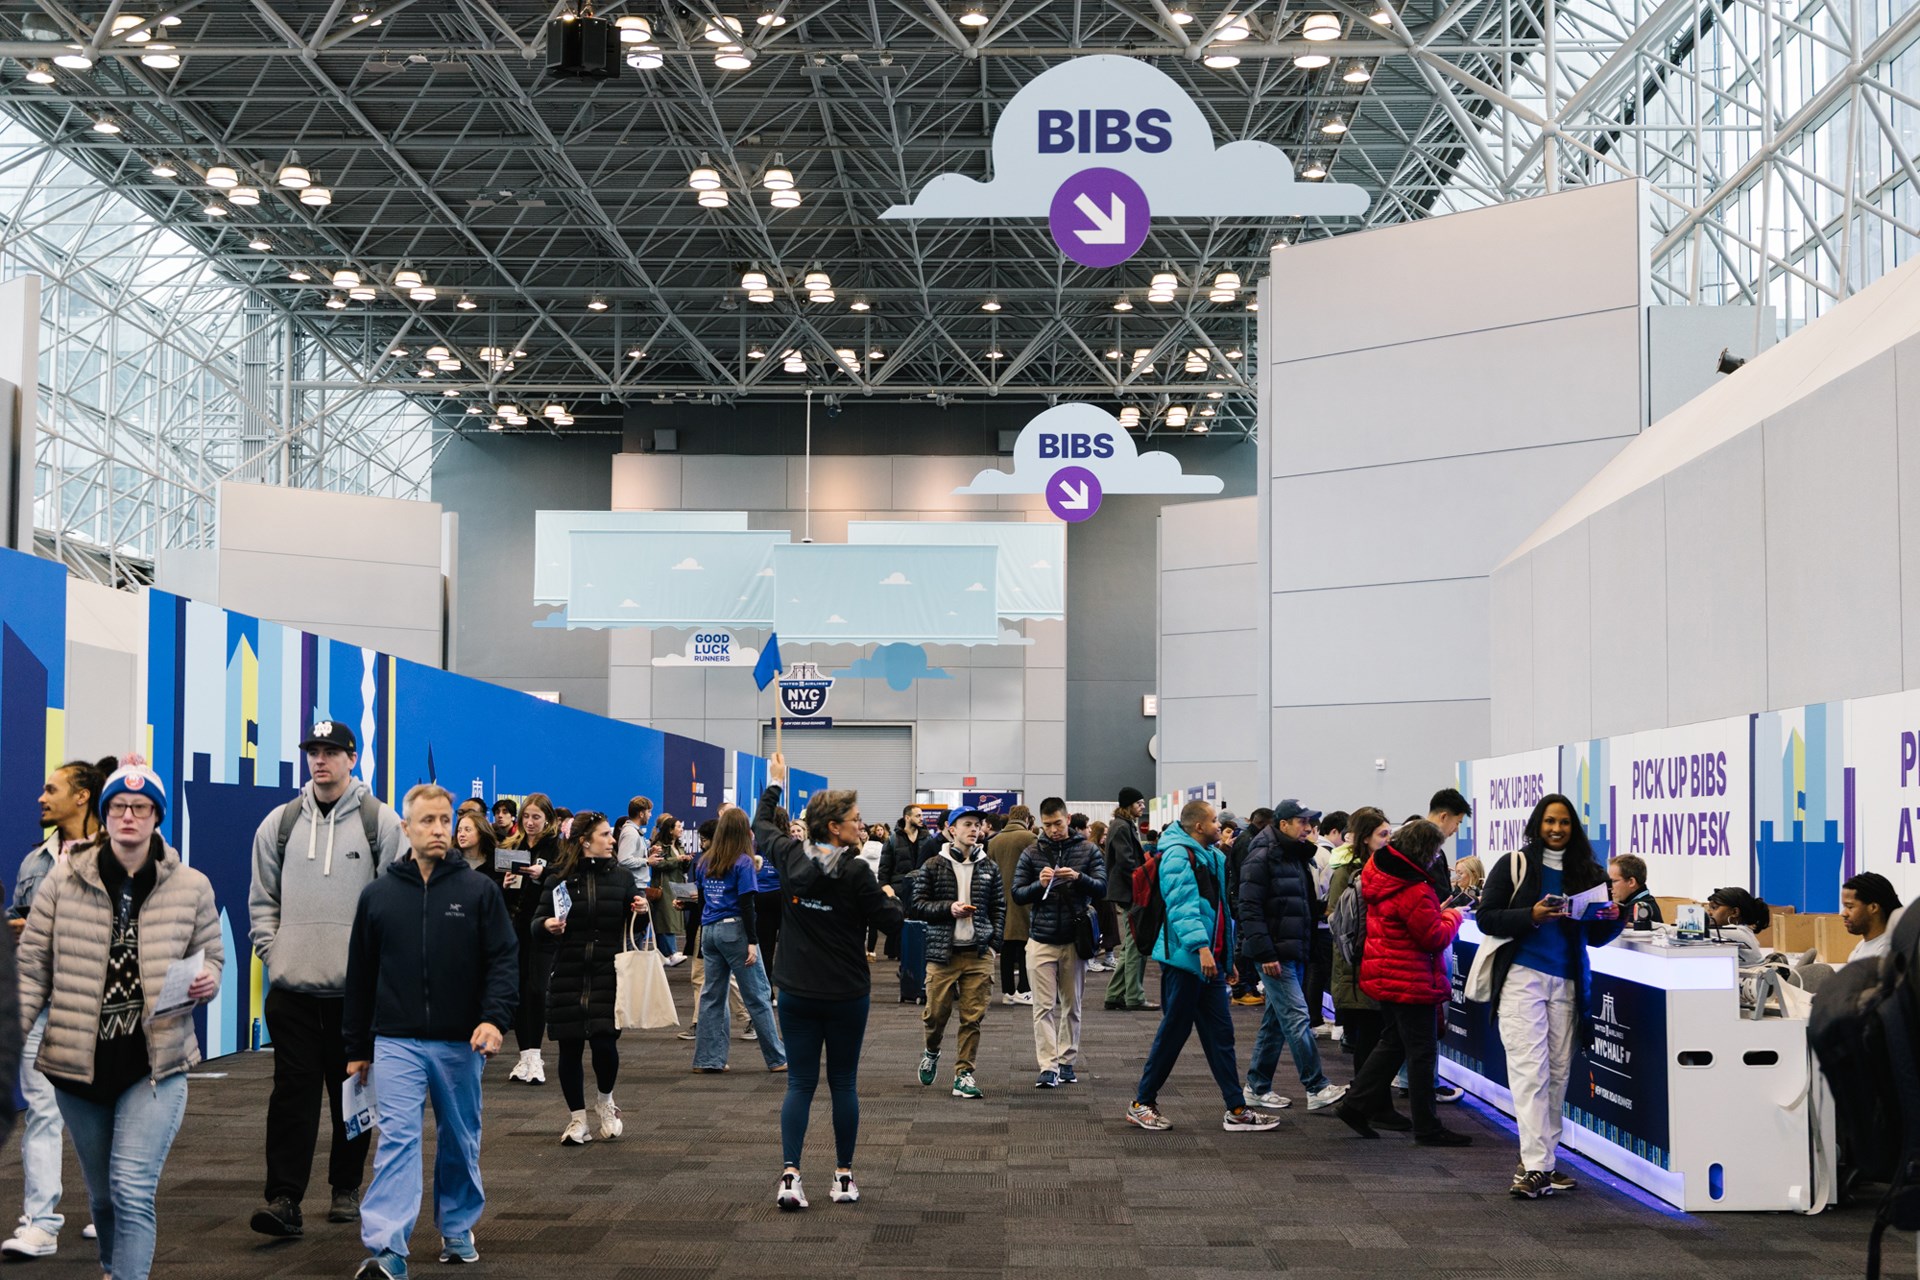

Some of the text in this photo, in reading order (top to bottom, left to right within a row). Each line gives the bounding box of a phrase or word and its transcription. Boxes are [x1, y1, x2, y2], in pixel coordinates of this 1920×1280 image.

[1038, 108, 1172, 154] BIBS
[1039, 432, 1114, 459] BIBS
[695, 634, 730, 644] GOOD
[695, 644, 729, 654] LUCK
[787, 688, 820, 701] NYC
[790, 701, 818, 710] HALF
[1632, 751, 1727, 800] PICK UP BIBS
[1901, 730, 1920, 787] P
[1490, 773, 1544, 810] PICK UP BIBS
[1489, 820, 1501, 851] AT
[1502, 820, 1520, 851] ANY
[1630, 811, 1731, 856] AT ANY DESK
[1896, 807, 1920, 864] A
